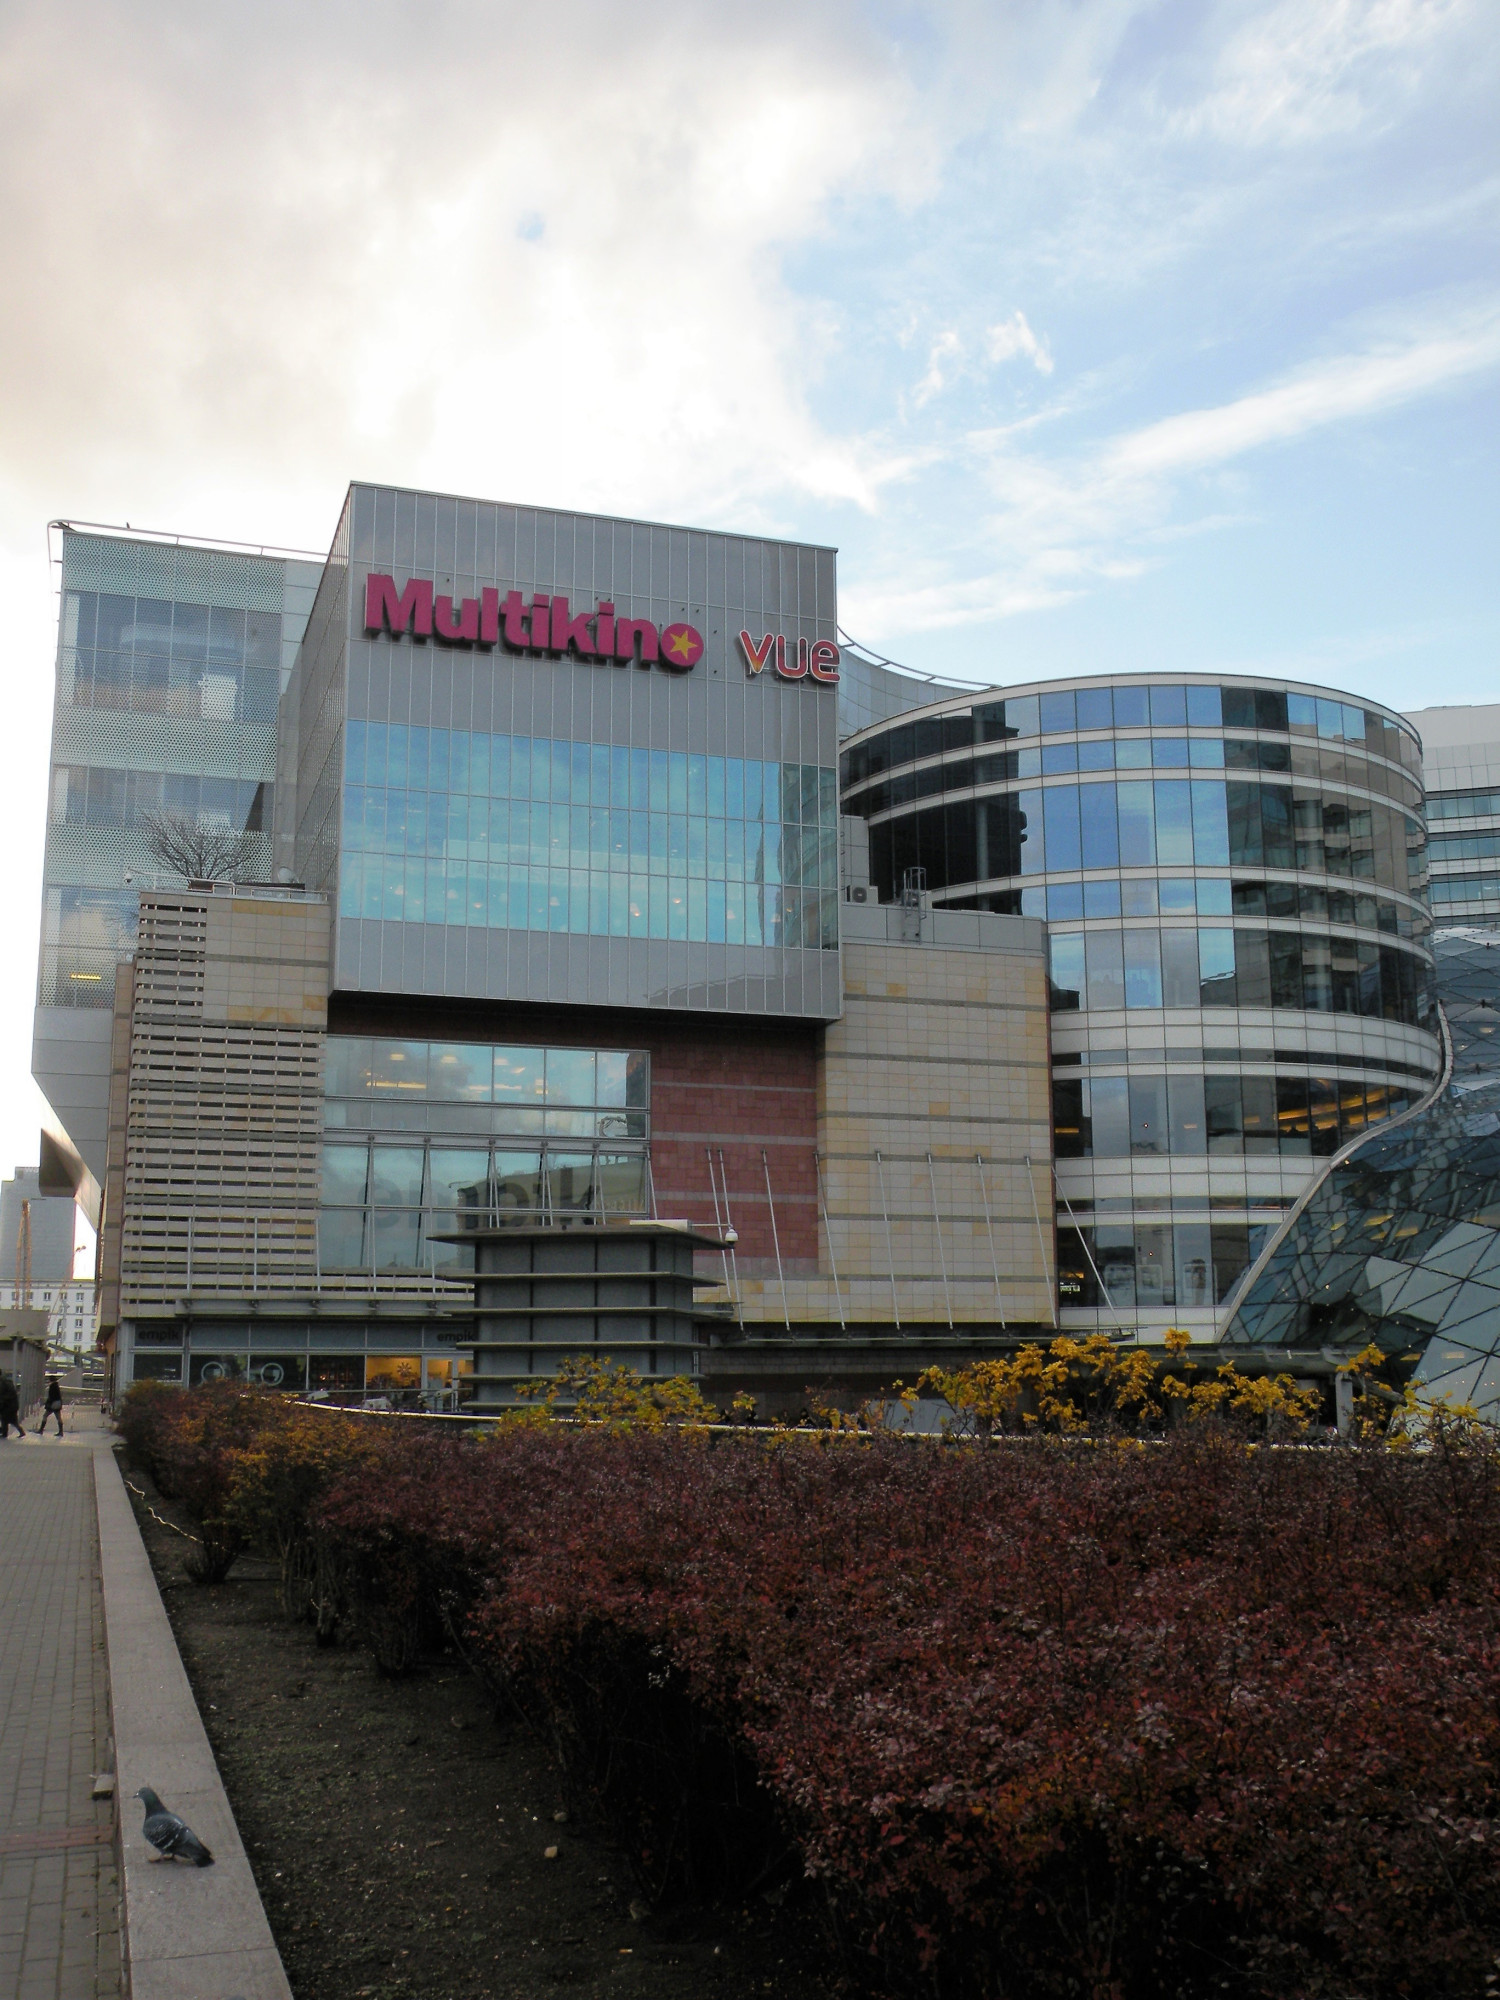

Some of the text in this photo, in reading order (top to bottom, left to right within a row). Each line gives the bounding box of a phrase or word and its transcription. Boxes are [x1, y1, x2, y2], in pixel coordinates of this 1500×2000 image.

[365, 573, 704, 669] Multikino
[740, 630, 840, 683] vue
[358, 1167, 601, 1229] empik
[138, 1328, 178, 1342] empik
